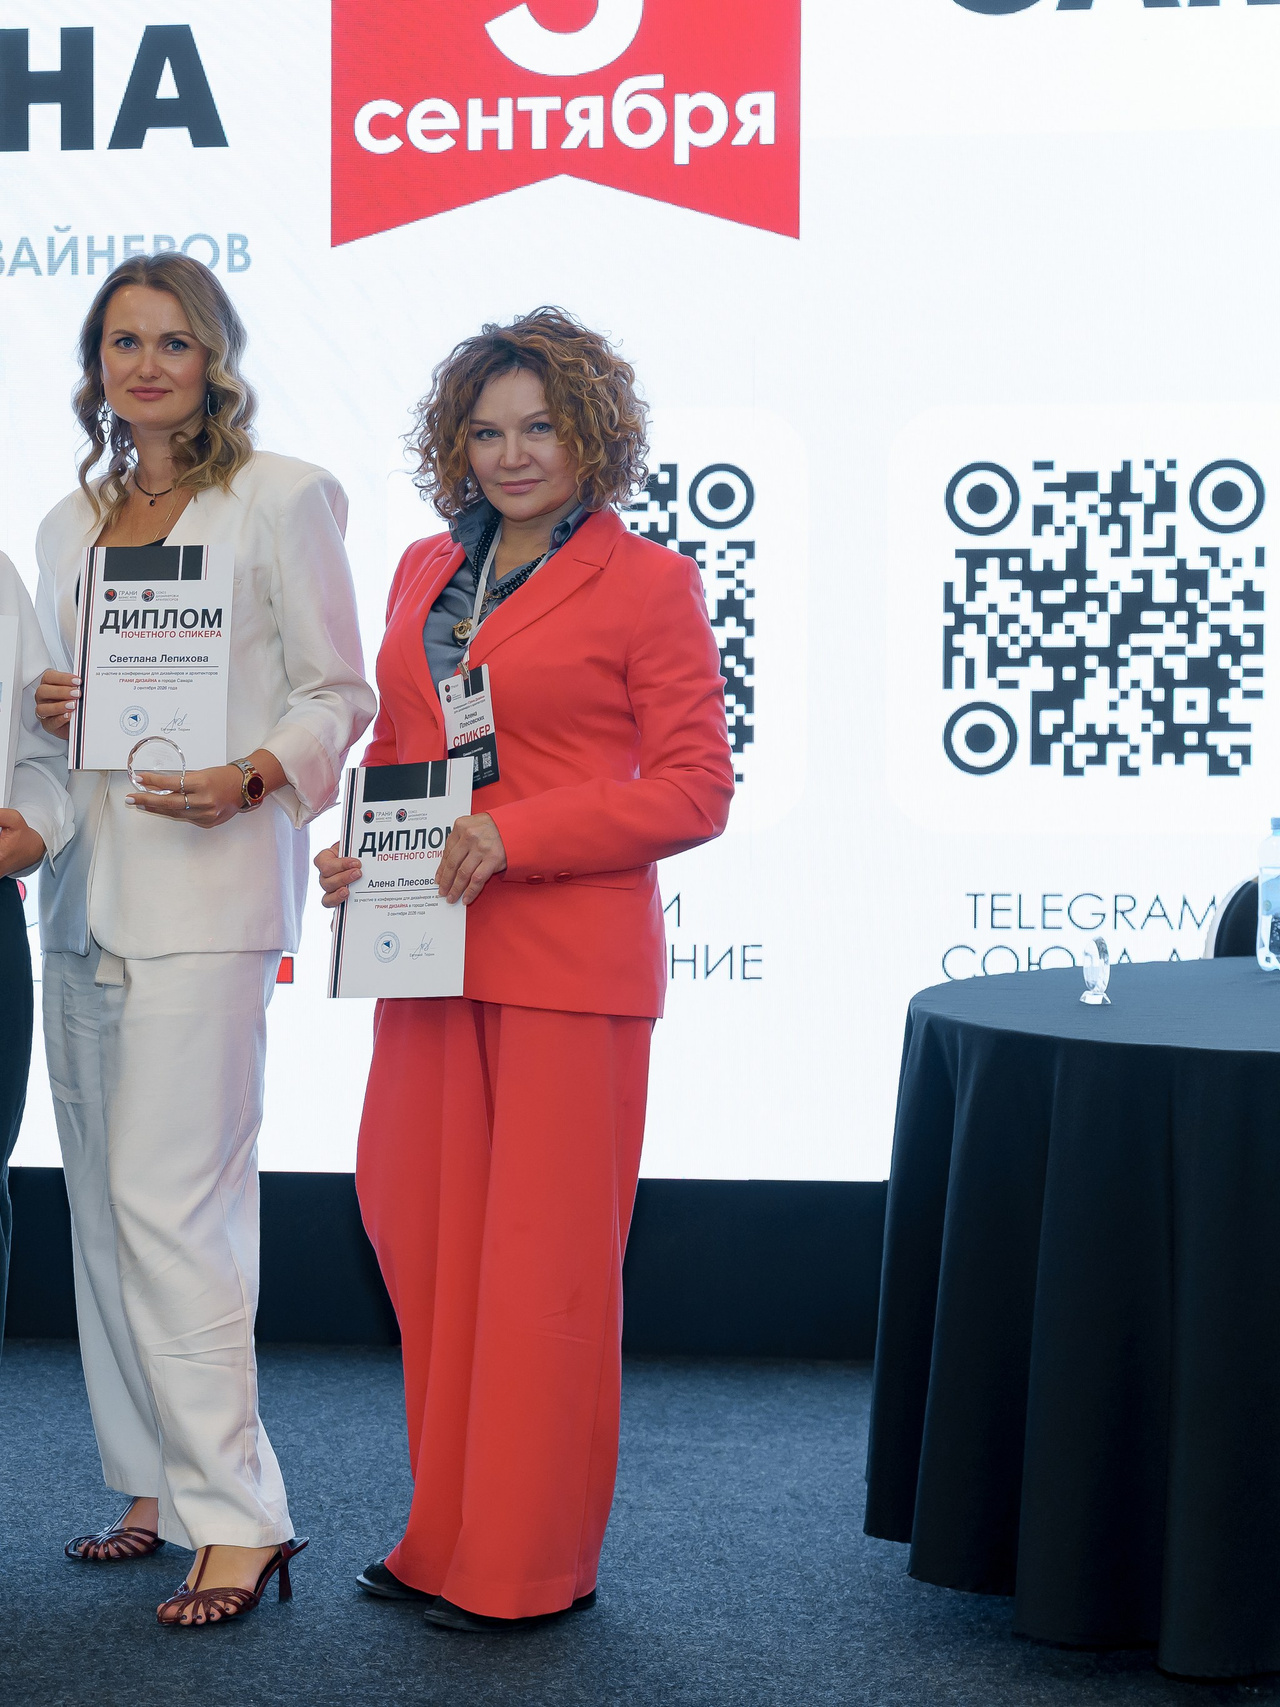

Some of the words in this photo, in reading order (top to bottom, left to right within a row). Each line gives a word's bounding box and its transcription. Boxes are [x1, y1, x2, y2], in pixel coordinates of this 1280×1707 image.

[353, 73, 777, 165] сентября
[99, 608, 222, 634] ДИПЛОМ
[179, 630, 222, 638] СПИКЕРА
[109, 654, 157, 663] Светлана
[160, 654, 209, 662] Лепихова
[453, 724, 490, 748] СПИКЕР
[358, 826, 452, 857] ДИПЛО
[377, 852, 425, 861] ПОЧЕТНОГО
[368, 879, 395, 888] Алена
[398, 878, 435, 887] Плесовс
[966, 893, 1216, 930] TELEGRAM
